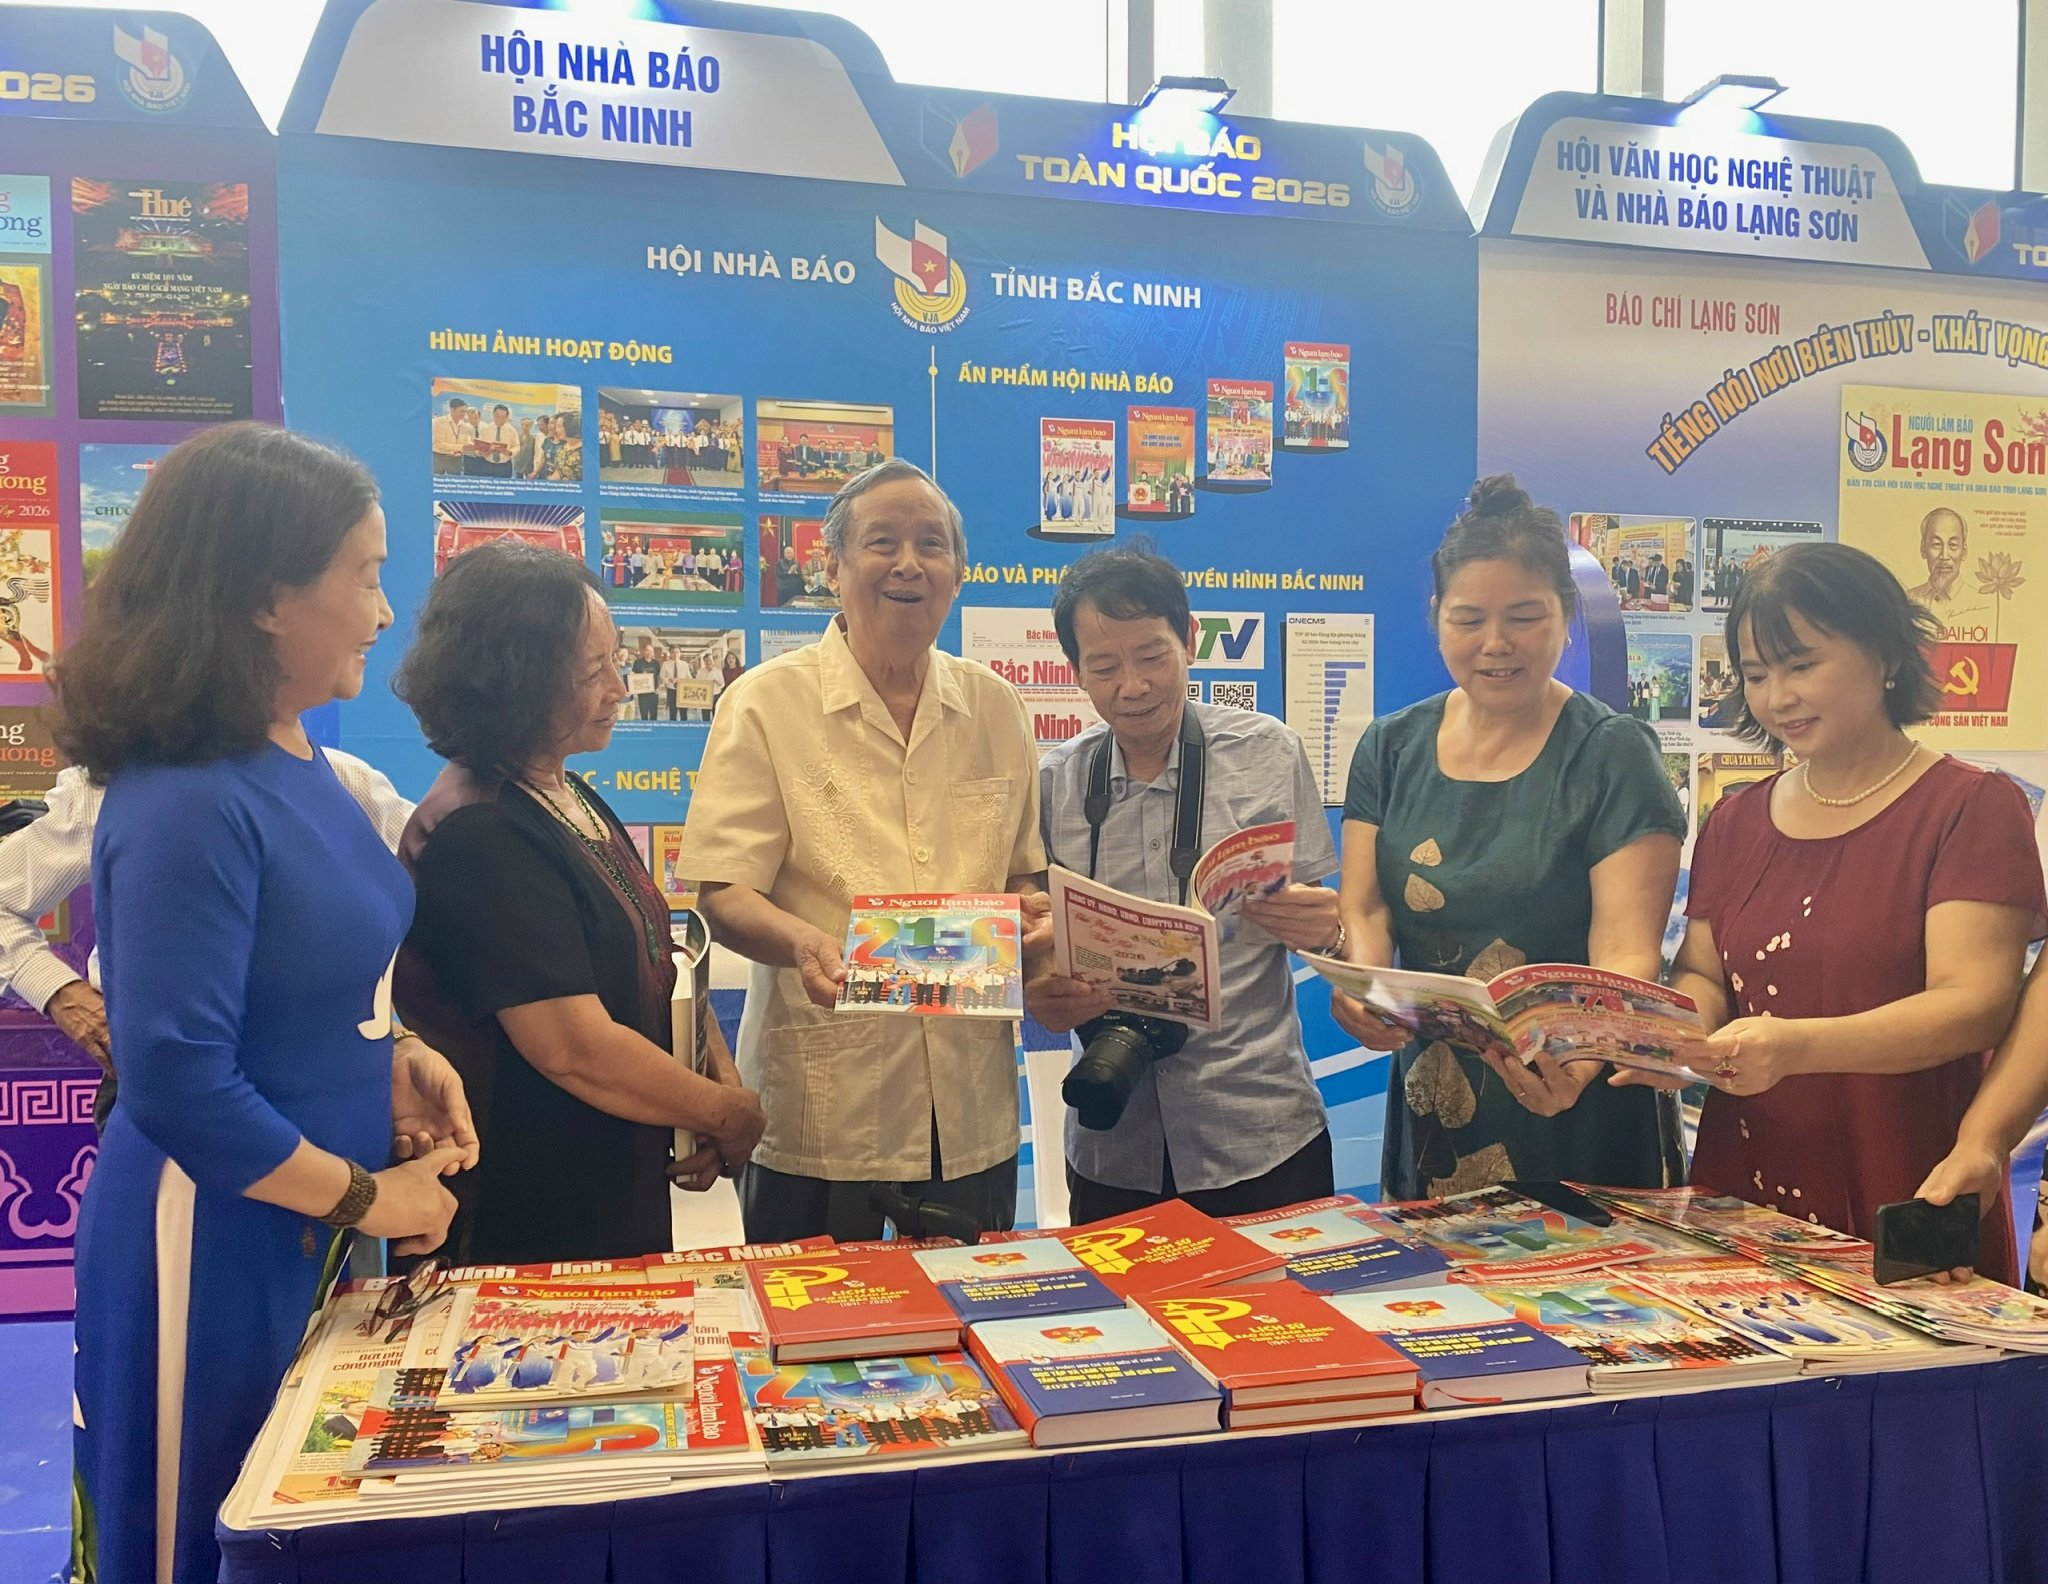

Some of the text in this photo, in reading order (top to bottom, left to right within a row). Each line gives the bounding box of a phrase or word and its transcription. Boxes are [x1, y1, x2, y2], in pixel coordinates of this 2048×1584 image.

[481, 29, 720, 94] HỘI NHÀ BÁO
[513, 86, 692, 148] BẮC NINH
[1016, 153, 1351, 208] TOÀN QUỐC 2026
[1557, 136, 1876, 203] HỘI VĂN HỌC NGHỆ THUẬT
[1576, 187, 1858, 243] VÀ NHÀ BÁO LẠNG SƠN
[647, 244, 857, 285] HỘI NHÀ BÁO
[991, 268, 1202, 310] TỈNH BẮC NINH
[890, 302, 971, 334] HỘI NHÀ BÁO VIỆT NAM
[1605, 290, 1781, 335] BÁO CHÍ LẠNG SƠN
[430, 326, 673, 366] HÌNH ẢNH HOẠT ĐỘNG
[958, 360, 1174, 394] ẤN PHẨM HỘI NHÀ BÁO
[1646, 387, 1724, 475] TIẾNG
[1709, 369, 1760, 422] NÓI
[1750, 344, 1800, 400] NƠI
[1795, 326, 1855, 377] BIÊN
[1854, 309, 1914, 359] THÙY
[1916, 329, 1931, 344] -
[1932, 310, 1992, 355] KHÁT
[1892, 414, 2046, 477] Lạng Sơn
[19, 505, 50, 517] 2026
[1003, 565, 1026, 585] VÀ
[1184, 566, 1364, 590] UYỀN HÌNH BẮC NINH
[1027, 630, 1041, 640] Bắc
[1195, 617, 1260, 662] TV
[1034, 714, 1082, 740] Ninh
[1991, 716, 2008, 727] NAM
[616, 767, 681, 796] NGHỆ
[848, 917, 1018, 968] 21-6
[1114, 950, 1146, 961] 2026
[662, 1243, 802, 1264] Bắc Ninh
[438, 1265, 517, 1284] Ninh
[526, 1288, 590, 1300] Người
[637, 1285, 676, 1297] báo
[696, 1326, 719, 1334] tâm
[333, 1361, 369, 1373] công
